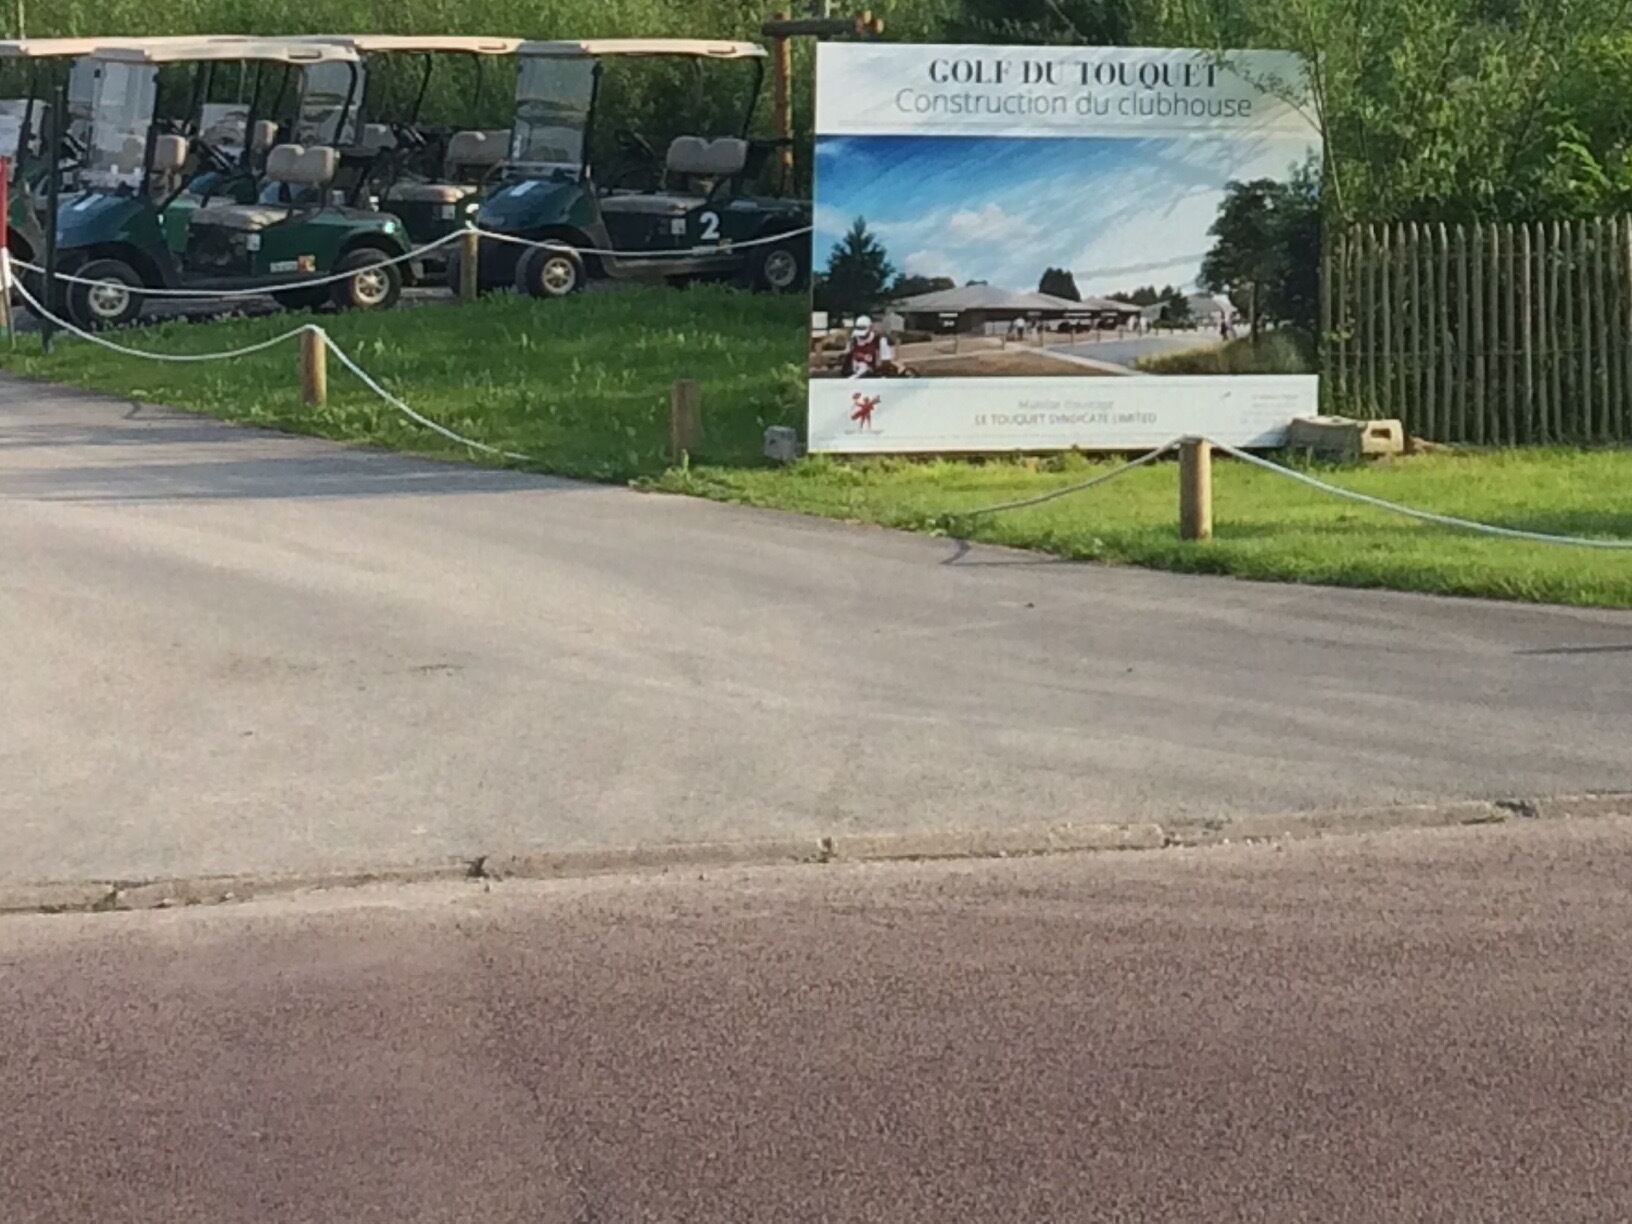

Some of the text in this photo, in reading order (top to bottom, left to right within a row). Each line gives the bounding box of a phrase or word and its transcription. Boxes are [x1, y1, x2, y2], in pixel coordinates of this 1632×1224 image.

[928, 58, 1219, 90] GOLF DU TOUQUET
[895, 87, 1253, 118] Construction du clubhouse
[699, 210, 720, 240] 2
